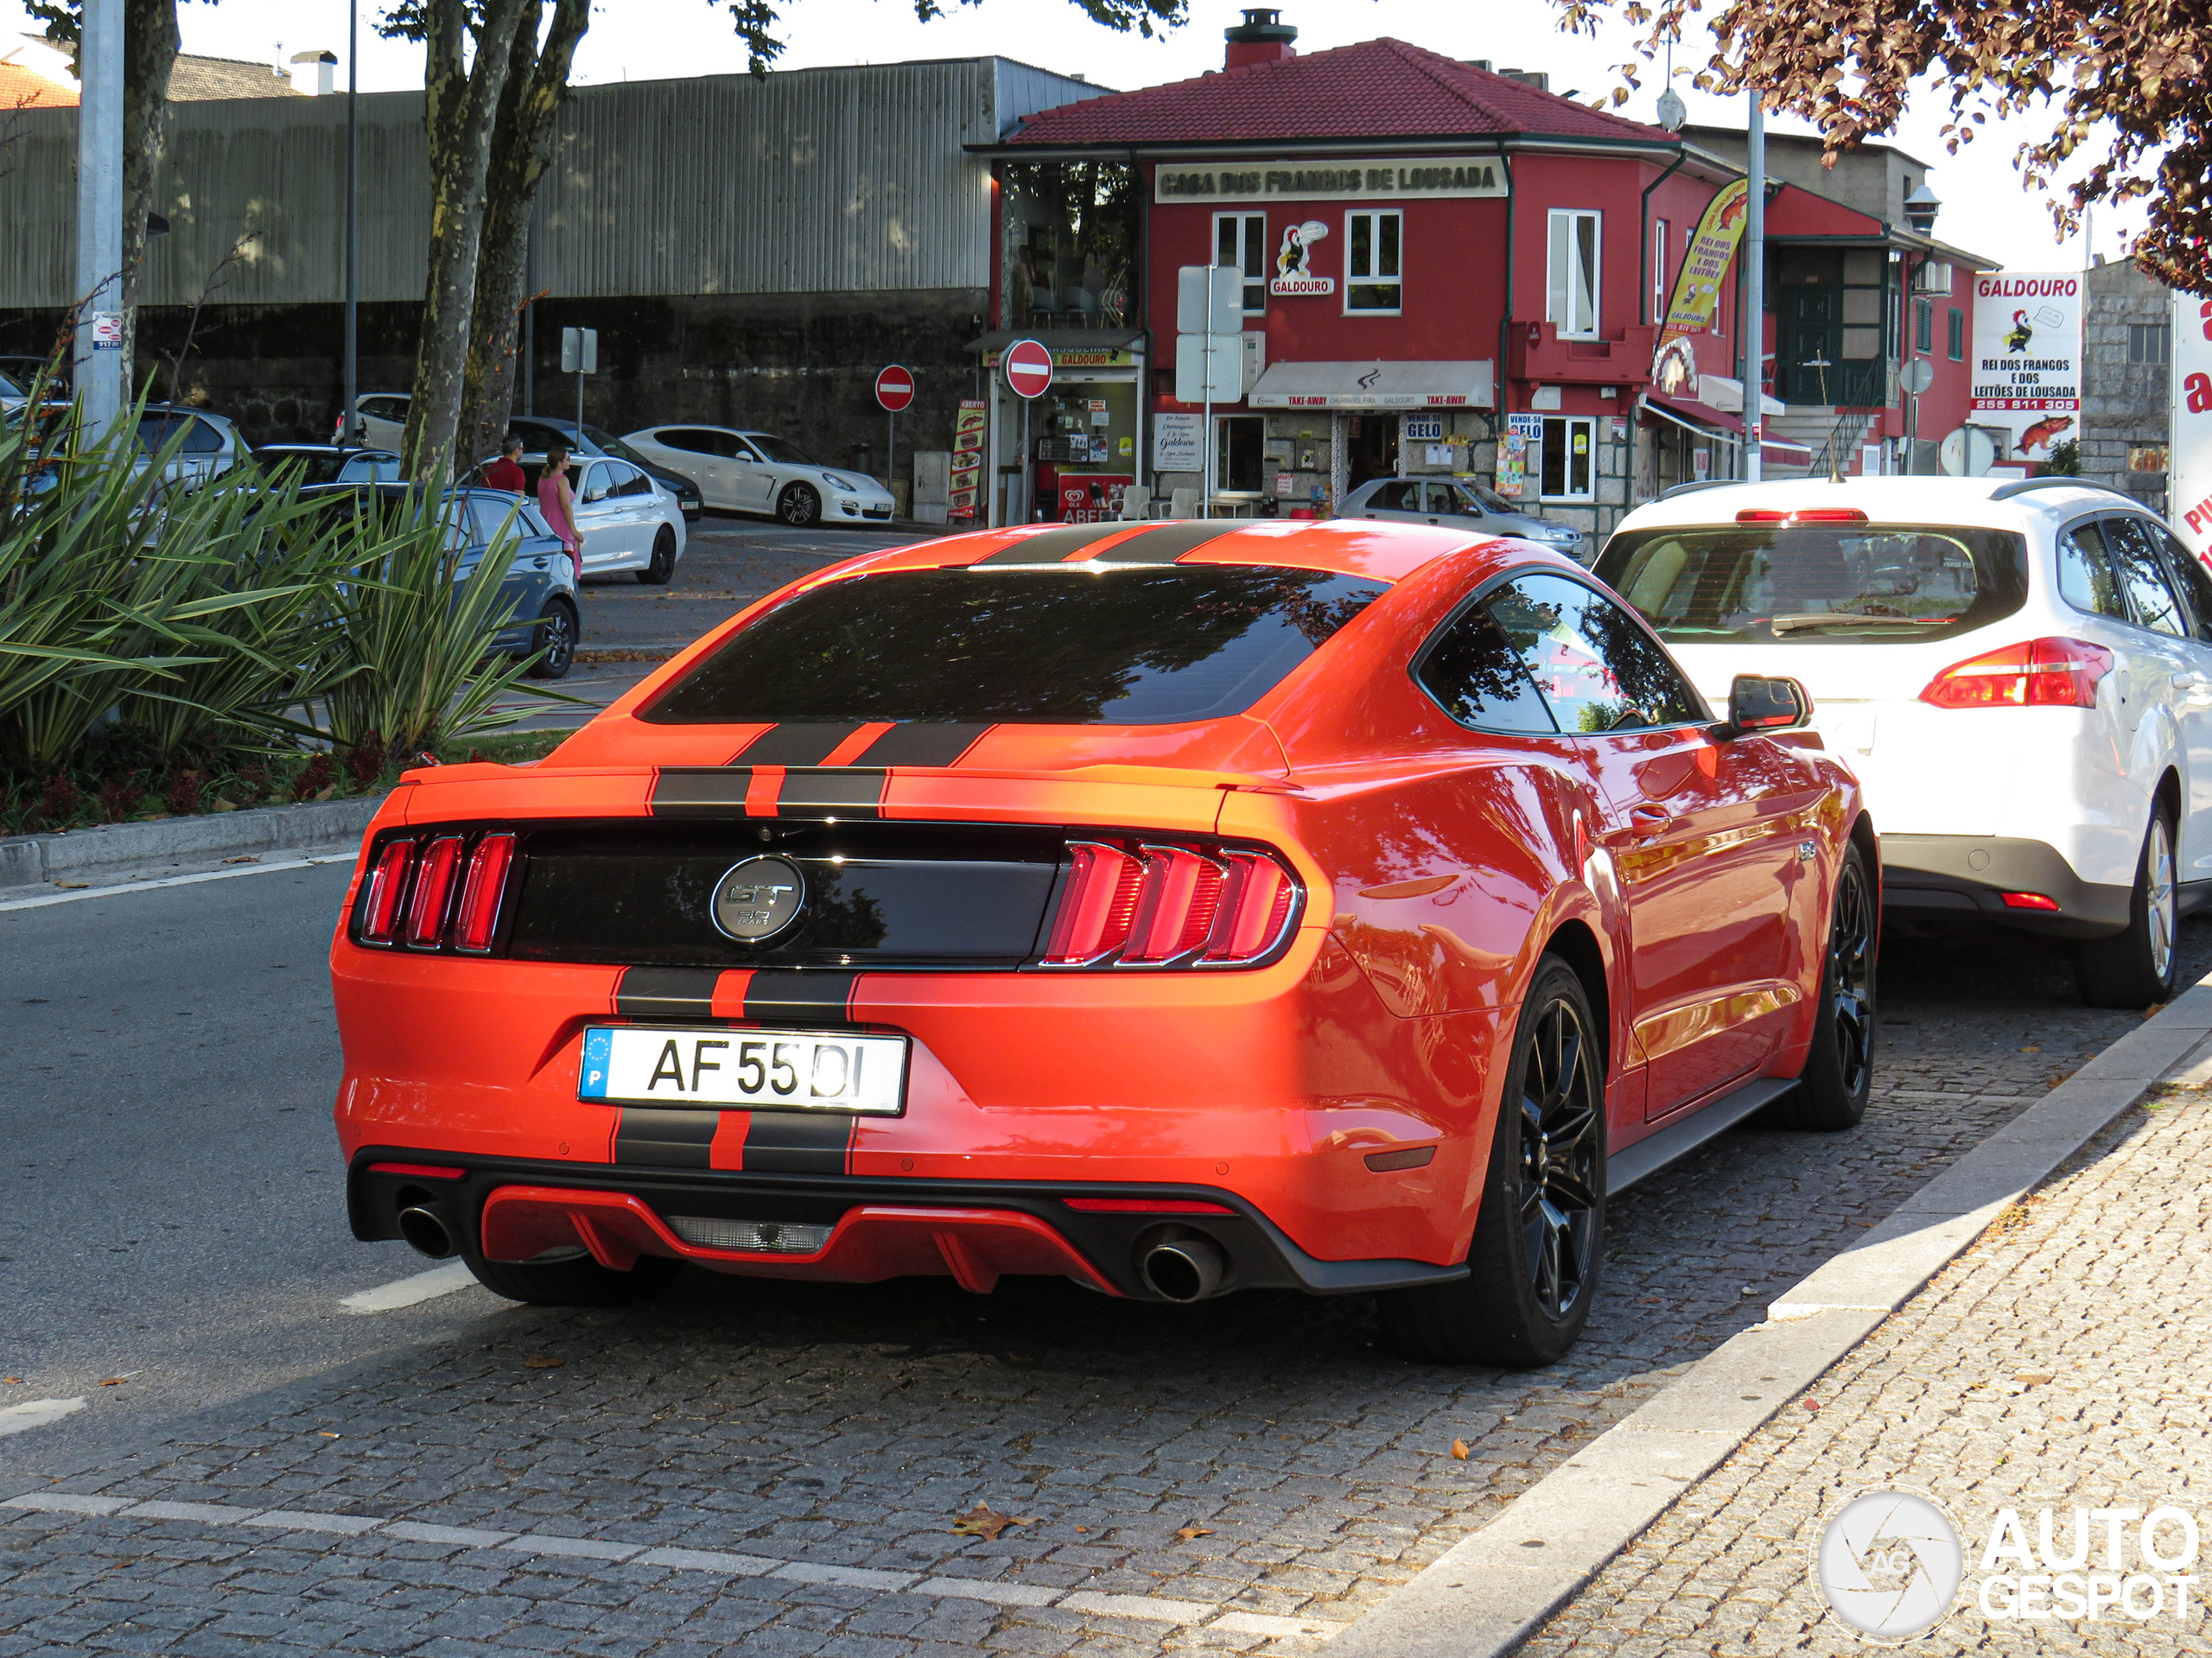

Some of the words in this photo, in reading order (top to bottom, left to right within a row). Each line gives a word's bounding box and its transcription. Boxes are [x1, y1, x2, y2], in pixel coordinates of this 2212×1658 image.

[1160, 172, 1216, 195] CASA
[1220, 171, 1262, 194] DOS
[1265, 168, 1362, 193] FRANGOS
[1366, 168, 1395, 191] DE
[1398, 166, 1497, 190] LOUSADA
[1700, 236, 1713, 247] REI
[1714, 239, 1731, 250] DOS
[1694, 245, 1730, 261] FRANGOS
[1703, 259, 1719, 269] DOS
[1688, 265, 1720, 279] LEITÕES
[1274, 281, 1328, 292] GALDOURO
[1978, 279, 2077, 297] GALDOURO
[1671, 312, 1706, 323] GALDOURO
[1062, 354, 1106, 365] GALDOURO
[1982, 359, 1998, 371] REI
[2000, 359, 2020, 371] DOS
[2023, 359, 2069, 371] FRANGOS
[2012, 373, 2017, 384] E
[2018, 373, 2039, 384] DOS
[1974, 384, 2013, 397] LEITÕES
[2016, 386, 2028, 397] DE
[2031, 386, 2075, 397] LOUSADA
[961, 400, 984, 409] ABERTO
[1288, 397, 1327, 405] TAKE-AWAY
[1427, 396, 1466, 405] TAKE-AWAY
[1976, 400, 2005, 410] 255
[2012, 400, 2039, 410] 811
[2045, 400, 2075, 410] 305
[1408, 423, 1440, 437] GELO
[726, 885, 793, 905] GT
[647, 1039, 729, 1092] AF
[738, 1042, 799, 1096] 55
[810, 1044, 864, 1098] DI
[589, 1070, 601, 1085] P
